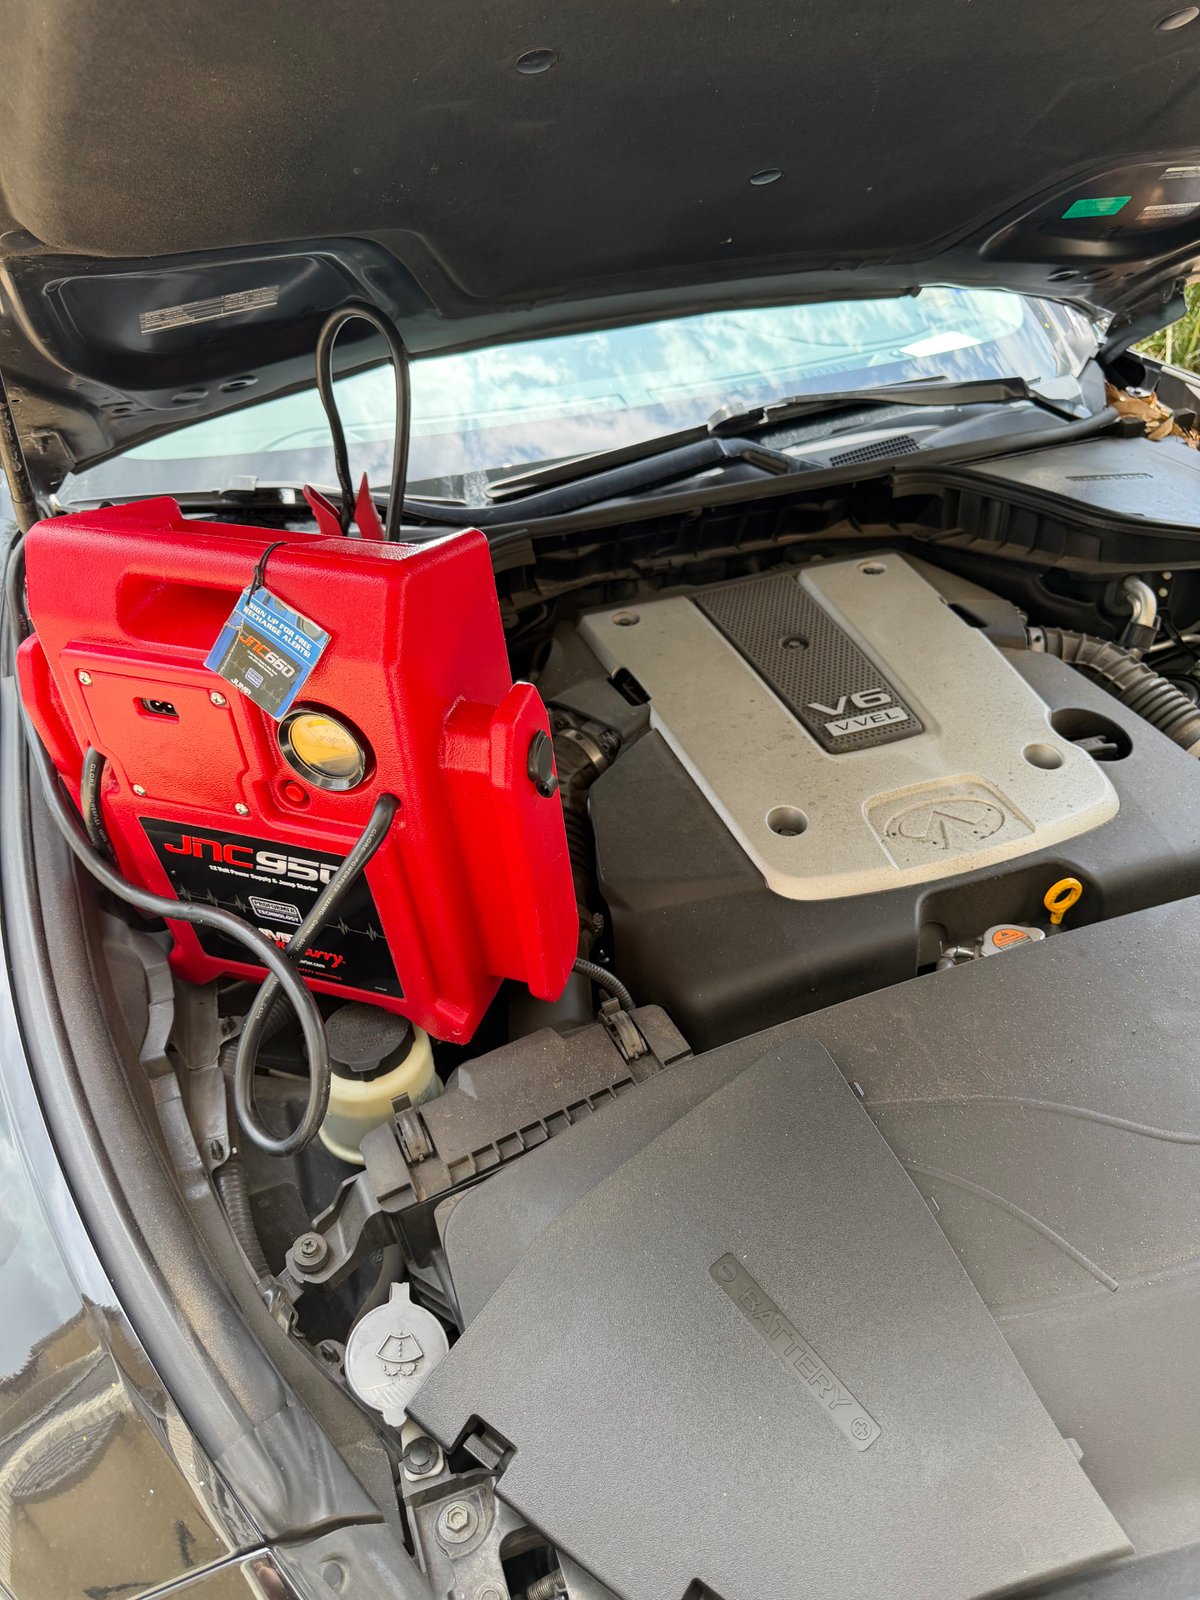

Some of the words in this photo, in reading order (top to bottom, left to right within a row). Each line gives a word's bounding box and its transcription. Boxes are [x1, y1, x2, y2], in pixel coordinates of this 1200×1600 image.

[243, 606, 282, 636] RECHARGE
[249, 602, 267, 618] SIGN
[267, 613, 279, 626] UP
[280, 622, 295, 638] FOR
[295, 633, 312, 650] FREE
[231, 678, 252, 696] JUMP
[807, 688, 892, 716] V6
[835, 712, 899, 731] VVEL
[359, 828, 377, 852] CLORE
[739, 1286, 852, 1409] BATTERY
